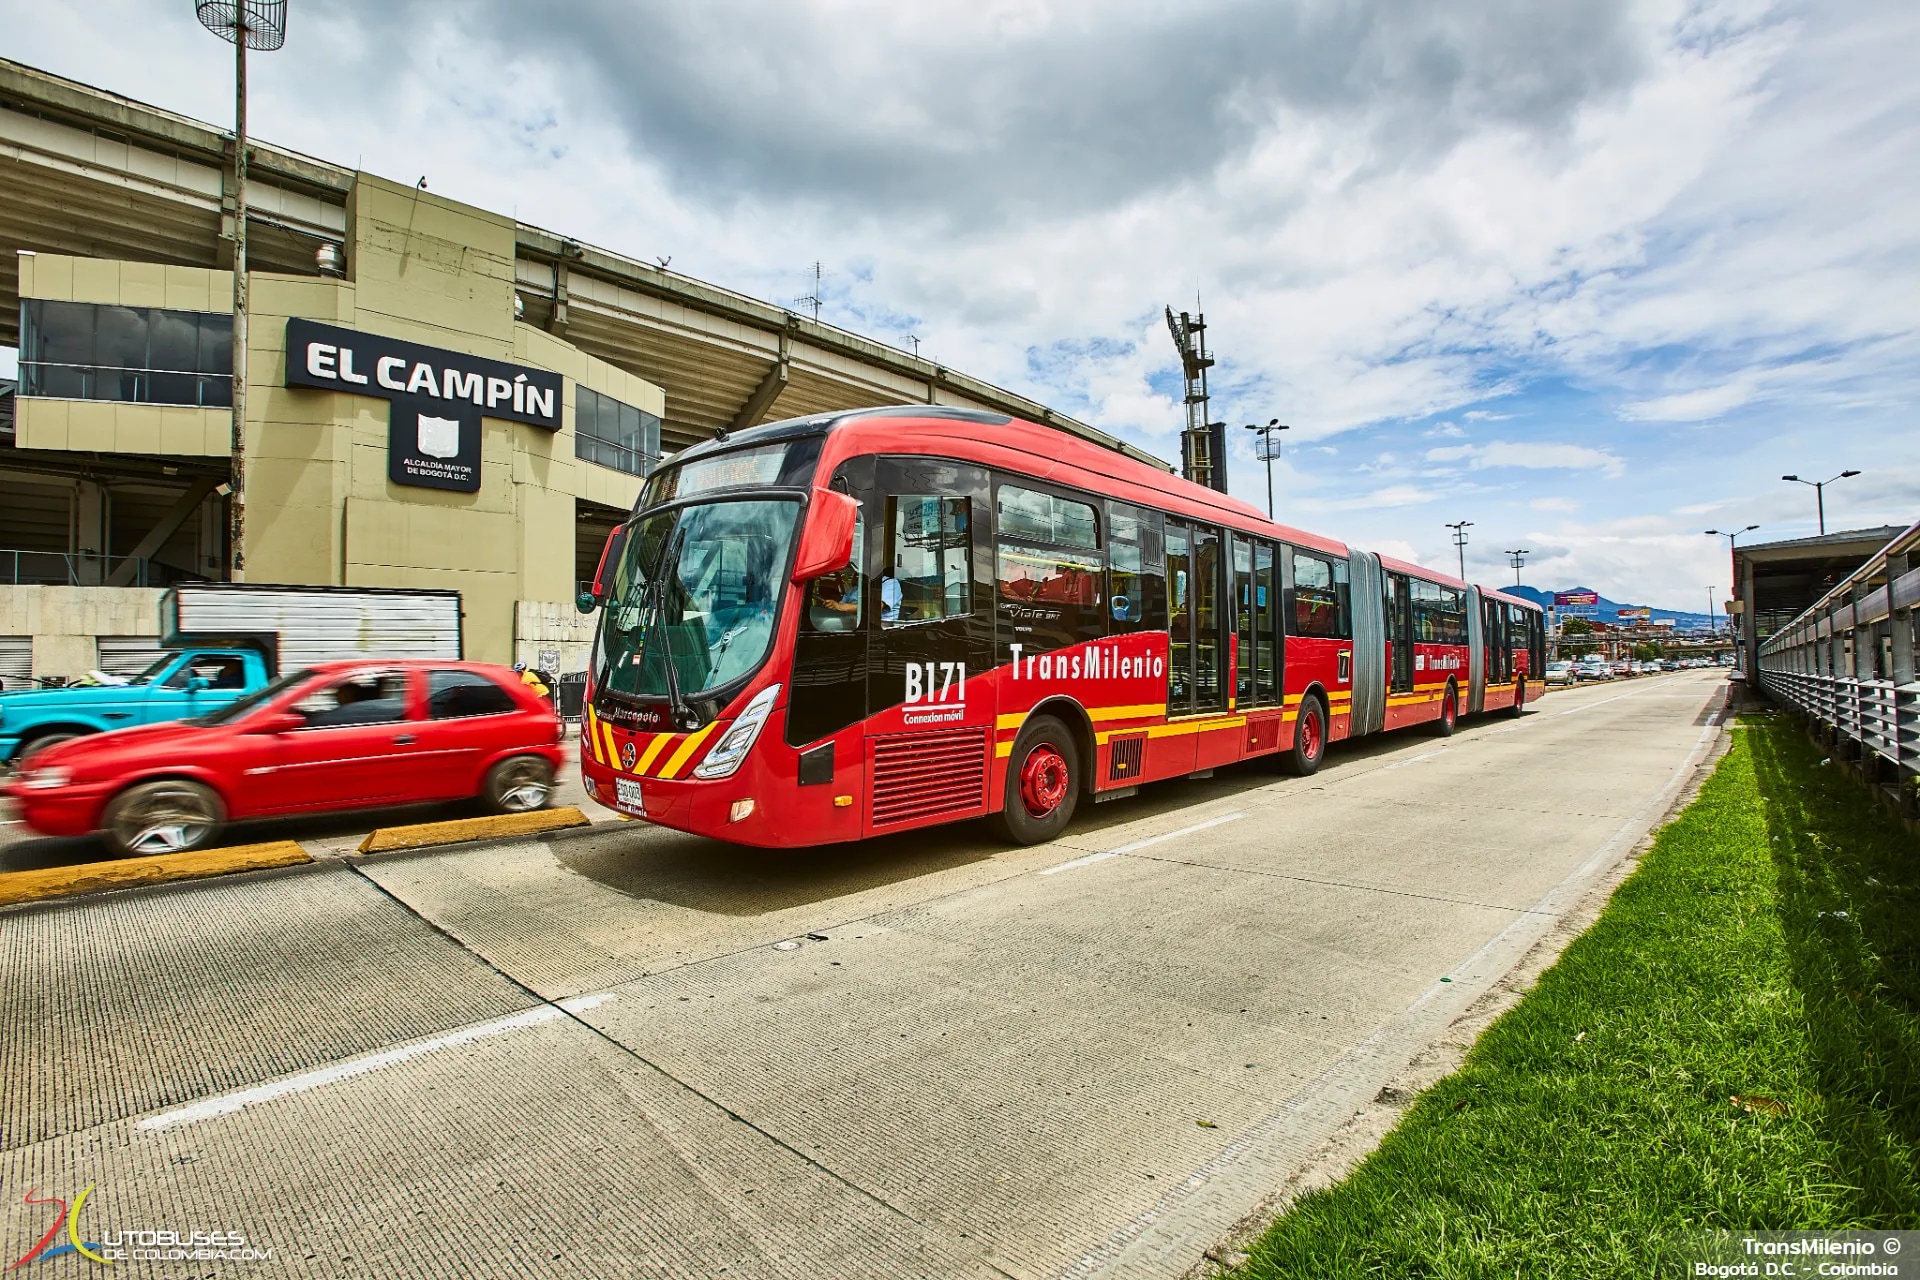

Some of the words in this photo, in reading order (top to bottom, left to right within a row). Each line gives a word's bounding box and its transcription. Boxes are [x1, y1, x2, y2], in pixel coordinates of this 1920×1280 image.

[306, 342, 368, 385] EL
[376, 355, 554, 418] CAMPÍN
[403, 458, 444, 470] ALCALDÍA
[444, 464, 472, 474] MAYOR
[407, 467, 419, 475] DE
[420, 468, 453, 479] BOGOTÁ
[454, 473, 469, 482] D.C.
[1010, 643, 1163, 680] TransMilenio
[905, 662, 966, 704] B171
[904, 711, 943, 725] Connexion
[944, 709, 964, 722] móvil
